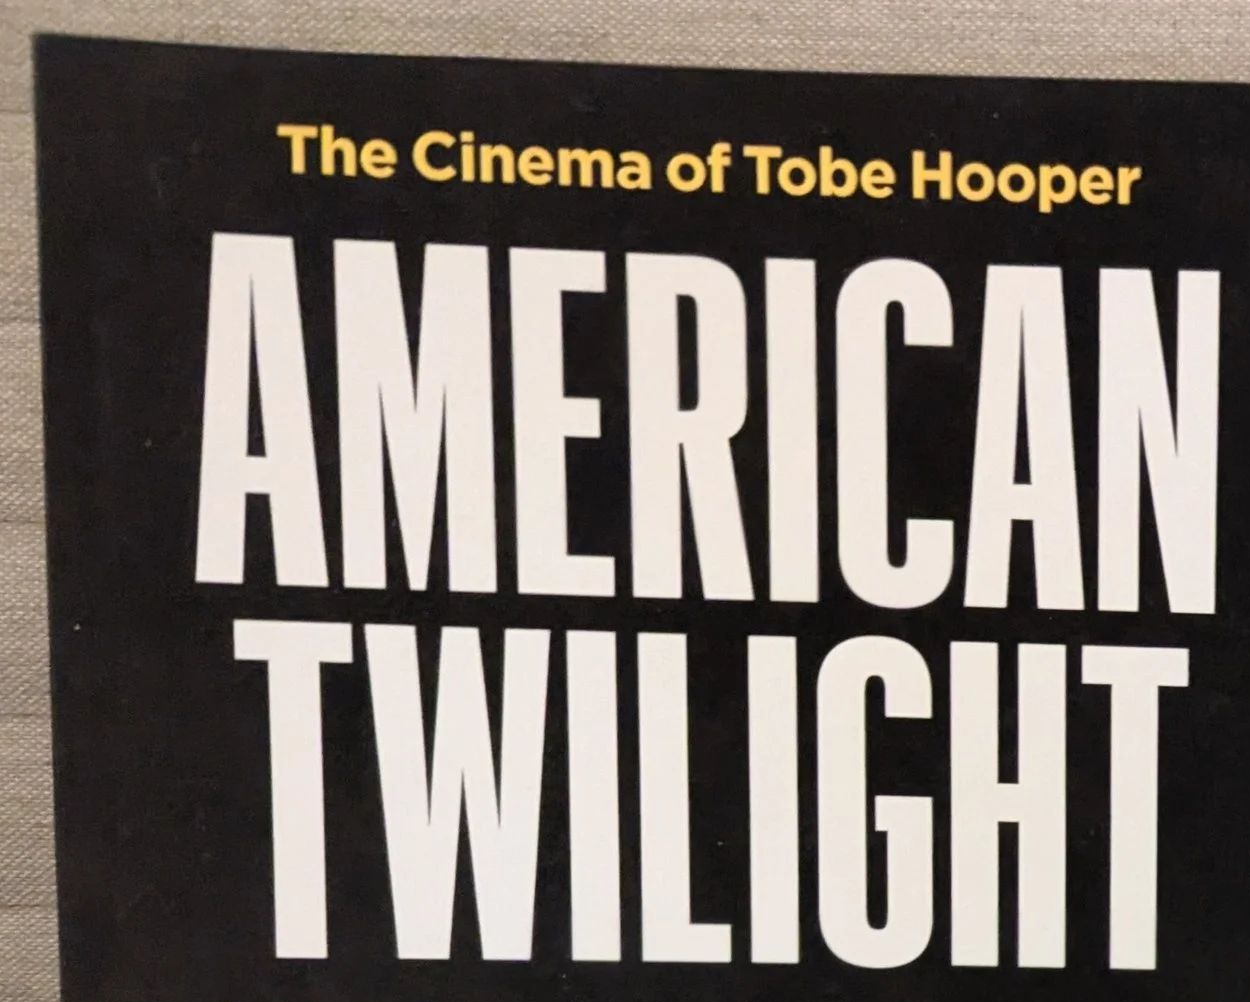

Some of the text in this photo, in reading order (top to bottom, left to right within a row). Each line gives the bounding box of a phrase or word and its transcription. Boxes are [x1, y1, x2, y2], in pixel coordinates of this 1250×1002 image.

[277, 124, 1143, 214] The Cinema of Tobe Hooper
[193, 232, 1221, 616] AMERICAN
[232, 619, 1191, 971] TWILIGHT
